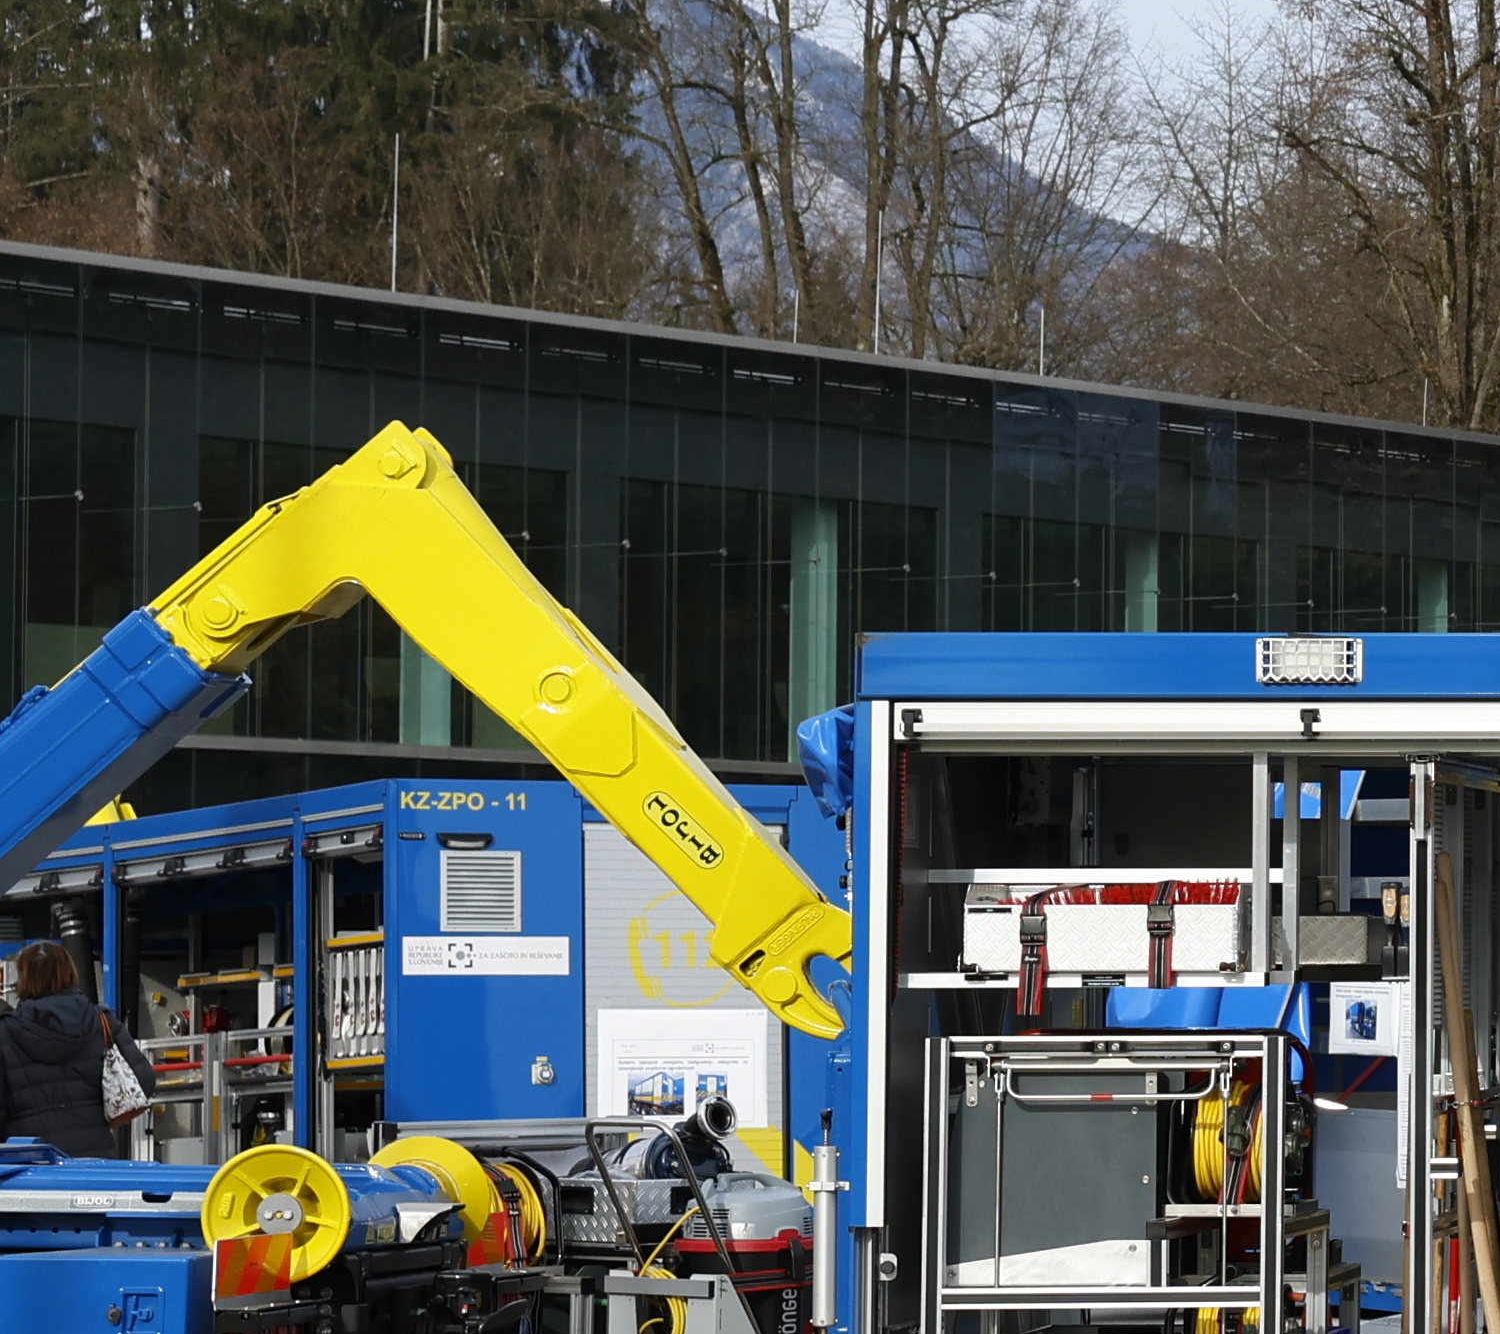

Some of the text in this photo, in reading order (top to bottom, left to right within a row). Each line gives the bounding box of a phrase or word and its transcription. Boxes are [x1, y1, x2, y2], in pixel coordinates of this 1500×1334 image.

[400, 791, 485, 811] KZ-ZPO
[505, 792, 527, 810] 11
[648, 796, 720, 864] BIJOL
[76, 1196, 110, 1206] BIJOL
